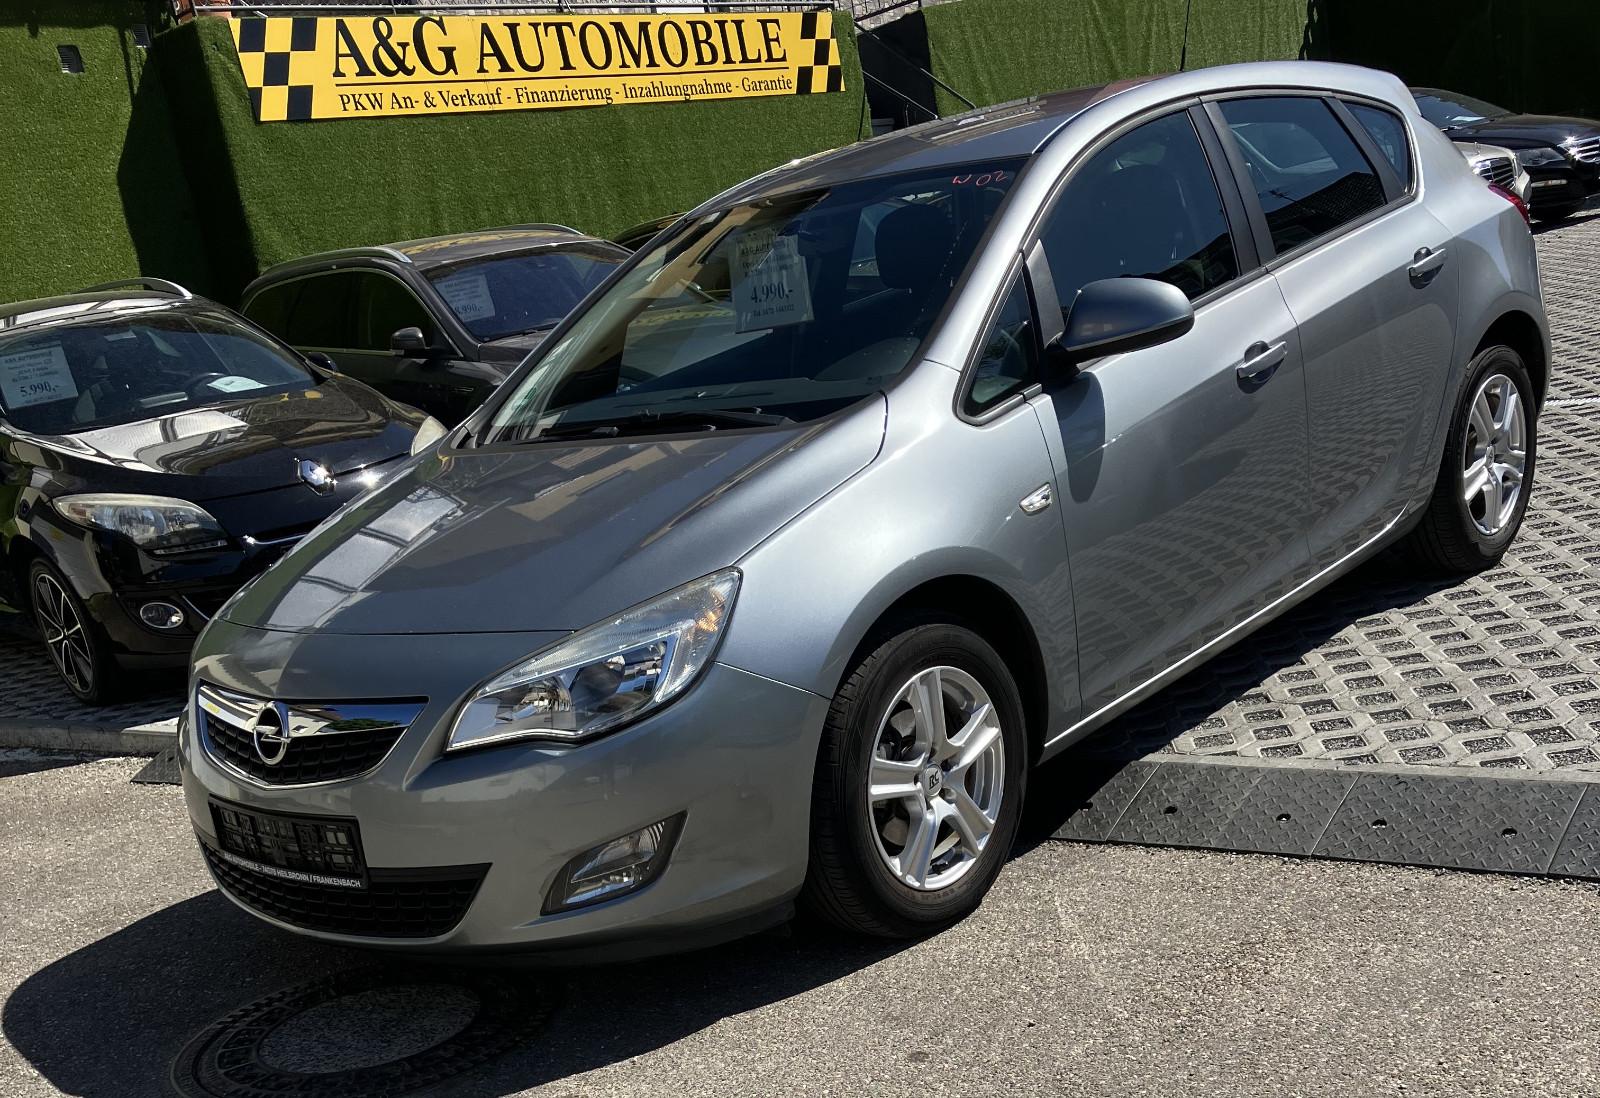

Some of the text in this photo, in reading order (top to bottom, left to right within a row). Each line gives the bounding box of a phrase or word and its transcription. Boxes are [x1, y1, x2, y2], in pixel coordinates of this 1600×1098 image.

[332, 16, 788, 78] A&G AUTOMOBILE
[338, 91, 384, 112] PKW
[390, 91, 420, 110] An-
[423, 90, 437, 108] &
[438, 86, 502, 108] Verkauf
[514, 83, 614, 105] Finanzierung
[621, 77, 733, 101] Inzahlungnahme
[741, 74, 793, 93] Garantie
[312, 874, 361, 888] FRANKENBACH
